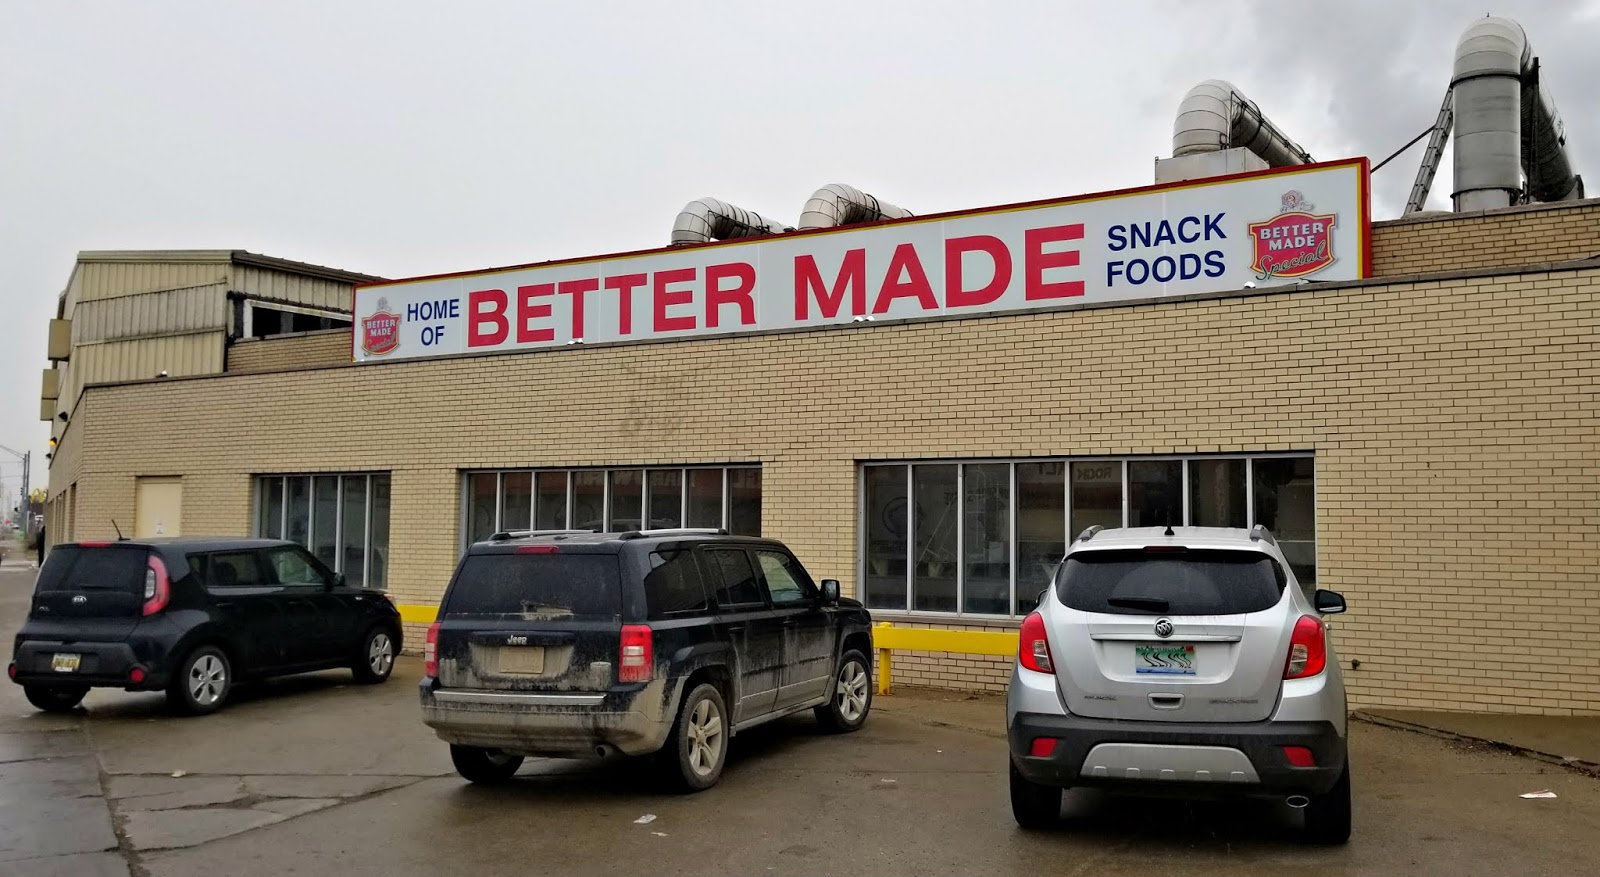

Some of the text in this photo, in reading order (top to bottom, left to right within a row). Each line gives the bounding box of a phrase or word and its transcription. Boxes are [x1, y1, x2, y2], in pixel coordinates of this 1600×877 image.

[1107, 212, 1227, 252] SNACK
[1260, 222, 1324, 240] BETTER
[1269, 235, 1315, 251] MADE
[1106, 249, 1226, 287] FOODS
[1255, 240, 1329, 280] Special
[468, 223, 1086, 348] BETTER MADE
[407, 298, 460, 322] HOME
[366, 319, 396, 329] BETTER
[370, 327, 391, 337] MADE
[421, 325, 445, 346] OF
[507, 635, 528, 645] Jeep
